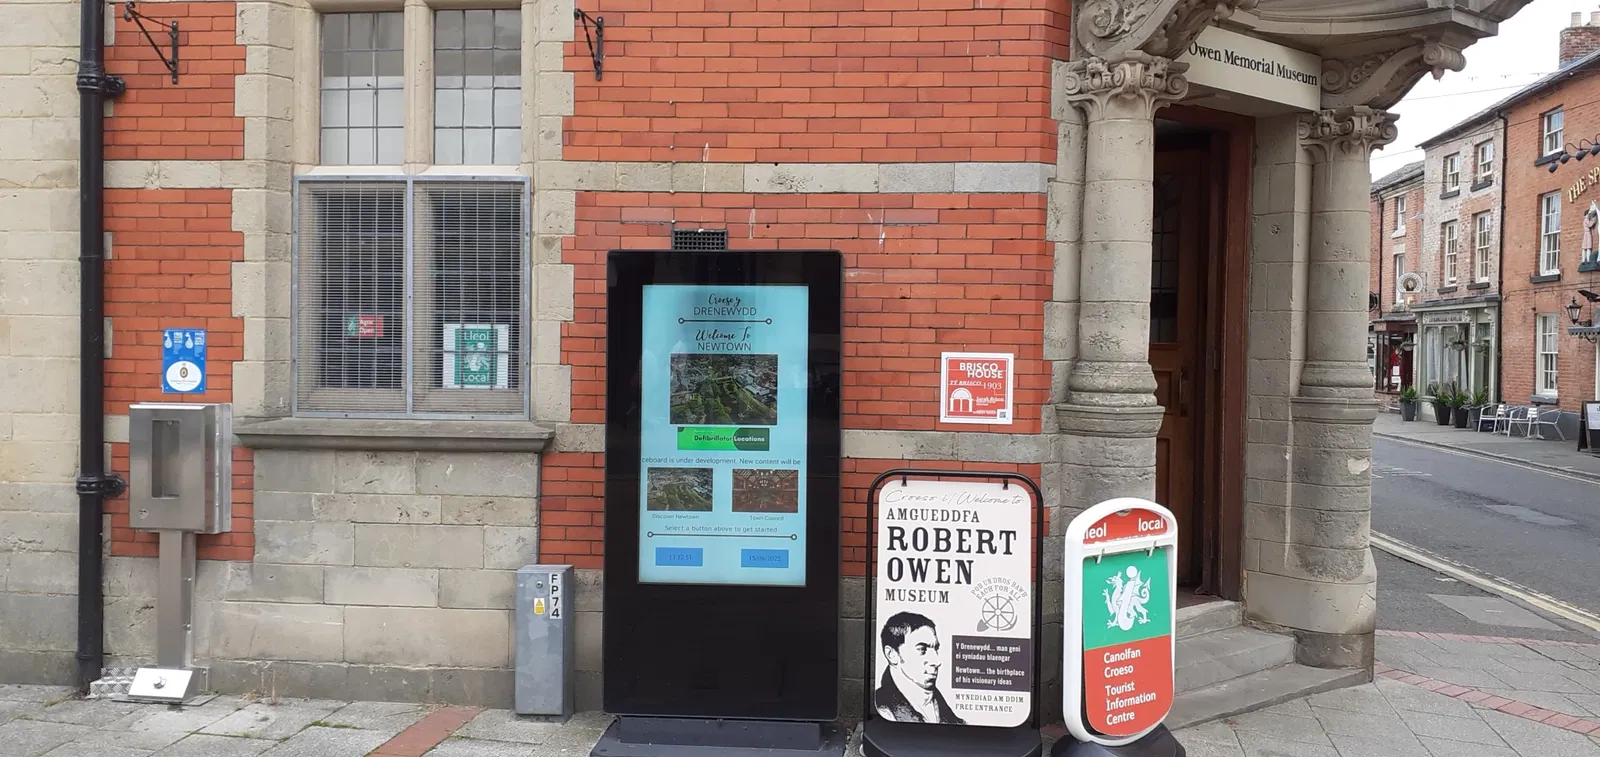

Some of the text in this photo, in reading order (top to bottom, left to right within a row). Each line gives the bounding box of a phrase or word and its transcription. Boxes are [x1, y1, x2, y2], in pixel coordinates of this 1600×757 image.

[1189, 42, 1317, 86] Owen Memorial Museum
[1568, 176, 1587, 203] THE
[708, 293, 734, 304] Croeso
[693, 307, 757, 316] DRENEWYDD
[464, 331, 490, 341] Lleol
[695, 326, 751, 341] Welcome To
[697, 342, 752, 351] NEWTOWN
[960, 363, 998, 371] BRISCO
[967, 370, 1003, 378] HOUSE
[463, 373, 490, 382] Local
[885, 489, 938, 503] Croeso
[956, 491, 1010, 505] Welcome
[1011, 496, 1023, 504] to
[886, 508, 980, 523] AMGUEDDFA
[1138, 517, 1163, 532] local
[887, 526, 1016, 555] ROBERT
[887, 557, 974, 585] OWEN
[971, 577, 1028, 598] POB UN DROS BAWD
[976, 587, 993, 600] EACH
[1009, 589, 1022, 602] ALL
[885, 588, 950, 603] MUSEUM
[962, 653, 986, 662] syniadau
[987, 654, 1010, 662] blaengar
[1104, 648, 1141, 663] Canolfan
[986, 667, 996, 675] the
[997, 667, 1025, 677] birthplace
[1104, 665, 1134, 678] Croeso
[972, 678, 996, 686] visionary
[1105, 681, 1135, 696] Tourist
[955, 693, 992, 701] MYNEDIAD
[1006, 695, 1024, 703] DDIM
[1106, 692, 1156, 711] Information
[975, 704, 1013, 712] ENTRANCE
[1106, 712, 1135, 725] Centre
